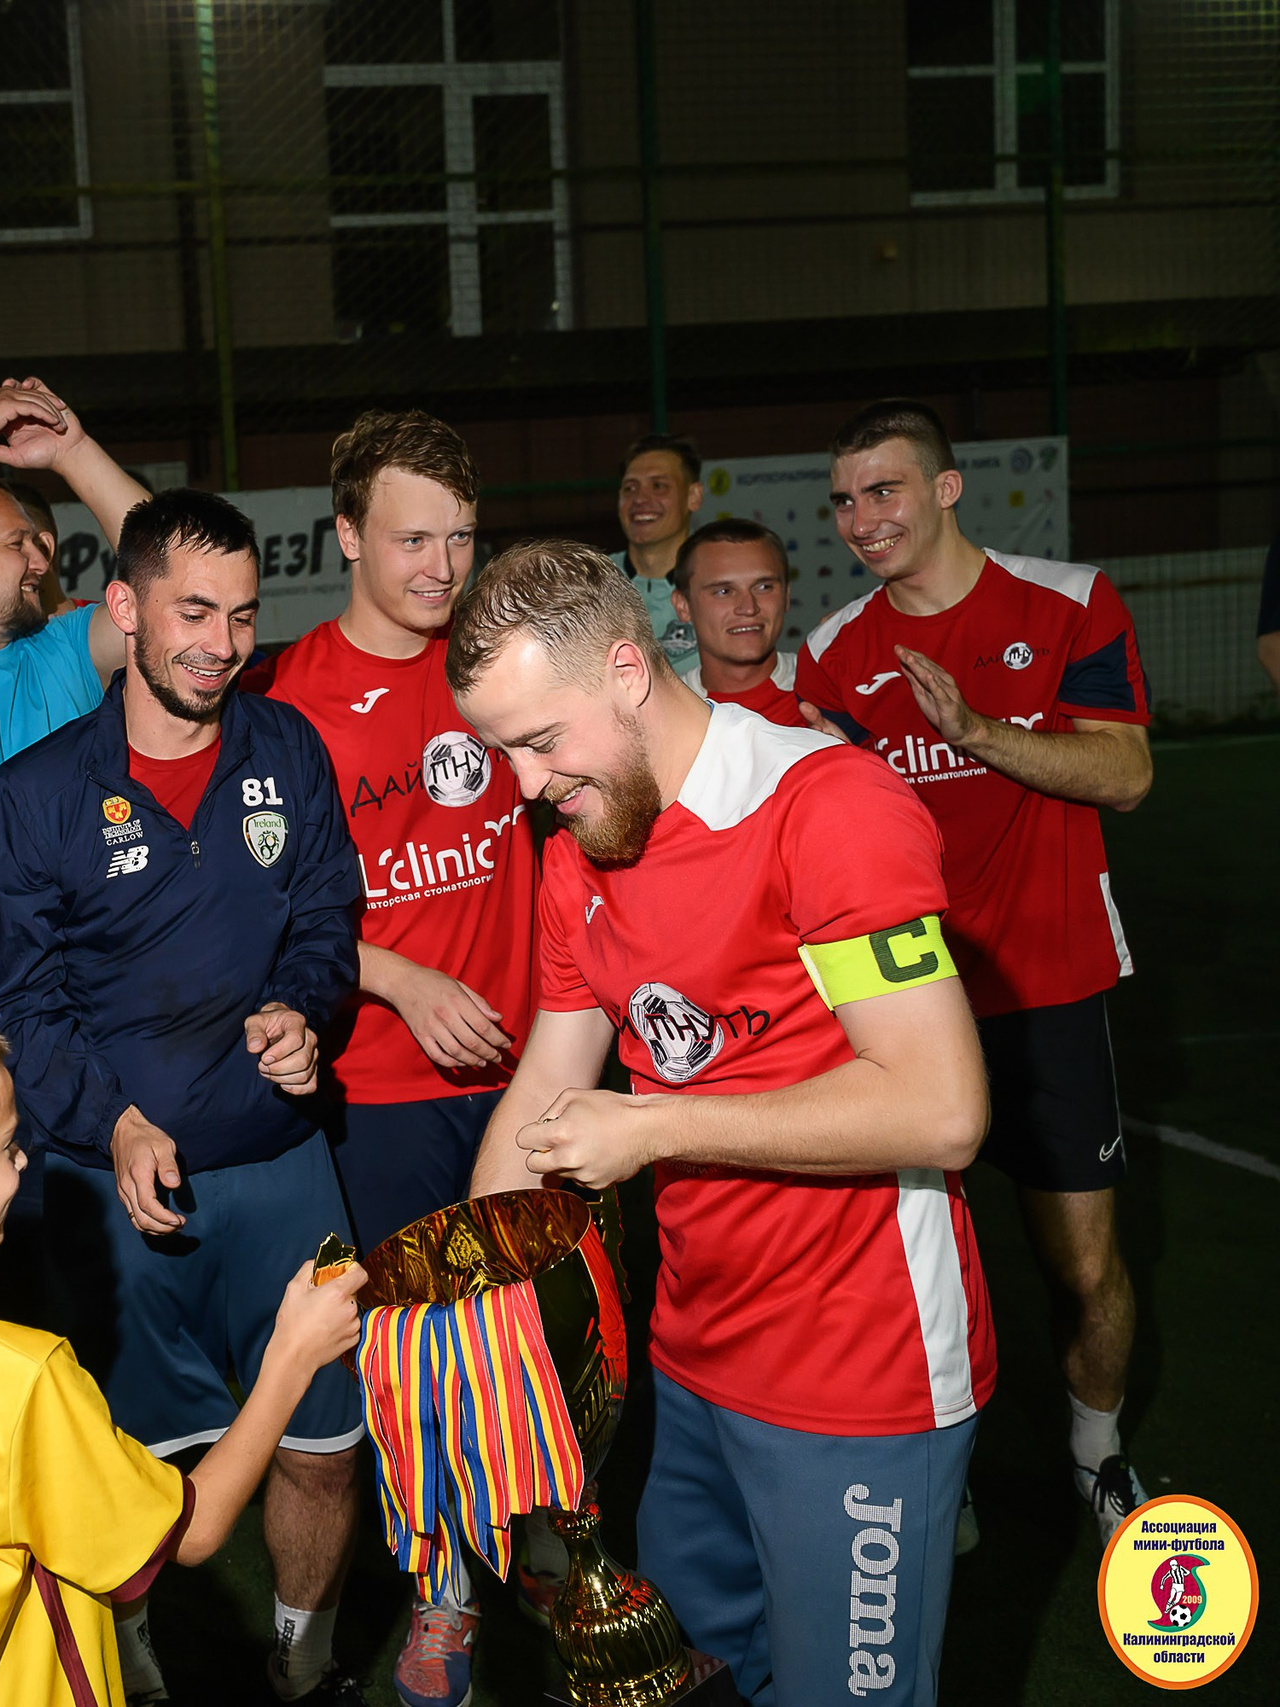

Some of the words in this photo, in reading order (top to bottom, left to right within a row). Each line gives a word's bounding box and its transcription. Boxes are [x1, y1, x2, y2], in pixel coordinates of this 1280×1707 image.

[350, 760, 424, 818] ДАЙ
[430, 746, 506, 785] ПНУ
[917, 765, 988, 785] стоматология
[242, 777, 284, 807] 81
[106, 831, 144, 846] CARLOW
[253, 818, 282, 829] Ireland
[423, 873, 494, 898] стоматологи
[868, 918, 939, 984] C
[645, 1005, 772, 1043] ПНУТЬ
[843, 1483, 902, 1697] Joma
